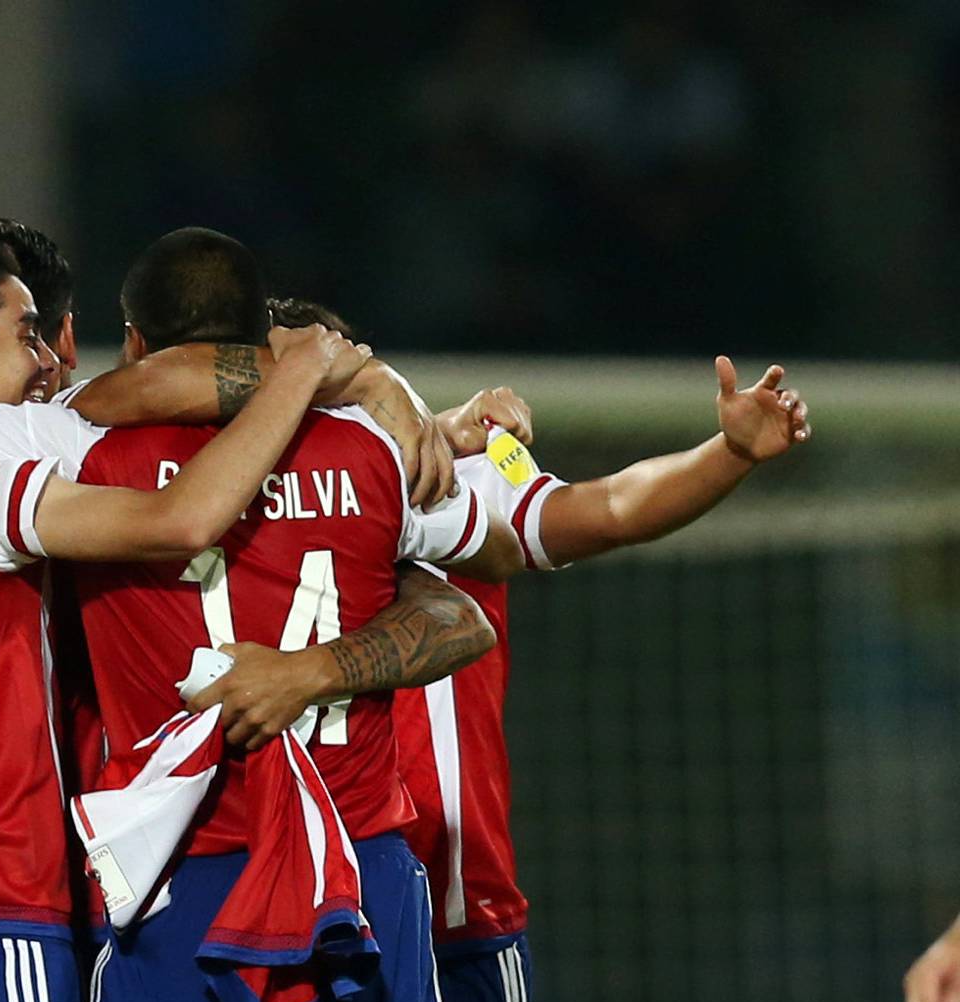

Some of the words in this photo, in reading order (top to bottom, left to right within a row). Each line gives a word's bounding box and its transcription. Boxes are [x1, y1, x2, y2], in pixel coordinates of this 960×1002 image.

[499, 447, 523, 471] FIFA
[263, 469, 361, 520] SILVA
[179, 546, 350, 745] 14
